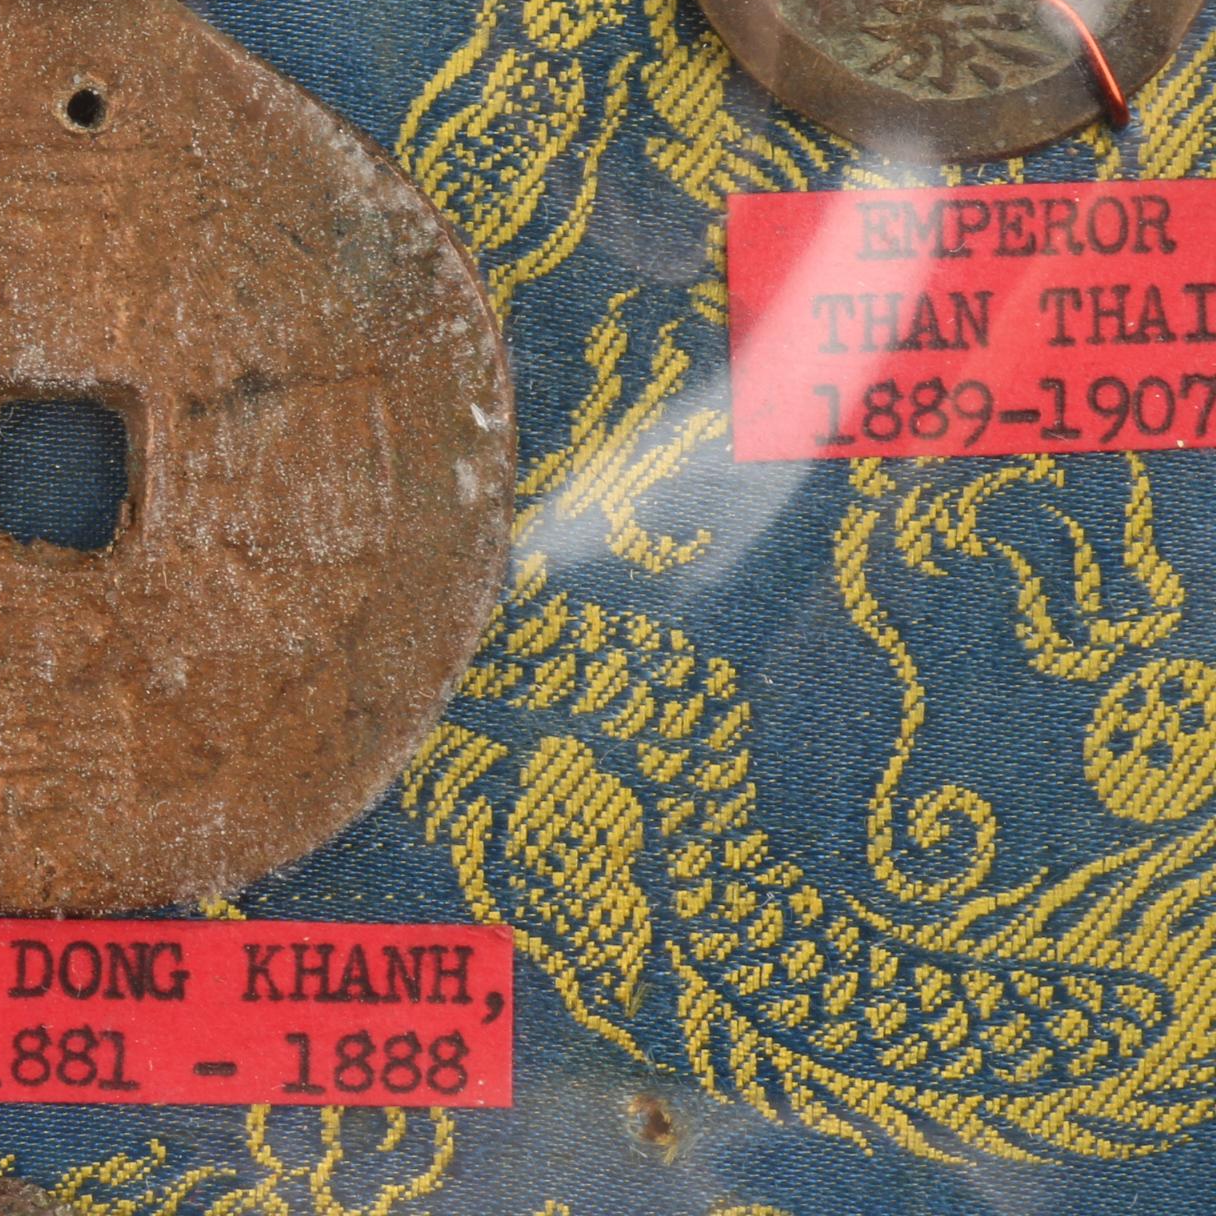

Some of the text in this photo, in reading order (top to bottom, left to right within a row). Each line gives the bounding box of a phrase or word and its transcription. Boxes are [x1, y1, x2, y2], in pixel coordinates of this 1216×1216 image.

[855, 194, 1178, 261] EMPEROR
[812, 282, 1216, 354] THAN THAI
[812, 373, 1216, 449] 1889-1907
[7, 938, 190, 1002] DONG
[240, 942, 506, 1025] KHANH,
[192, 1060, 238, 1078] -
[282, 1029, 470, 1097] 1888
